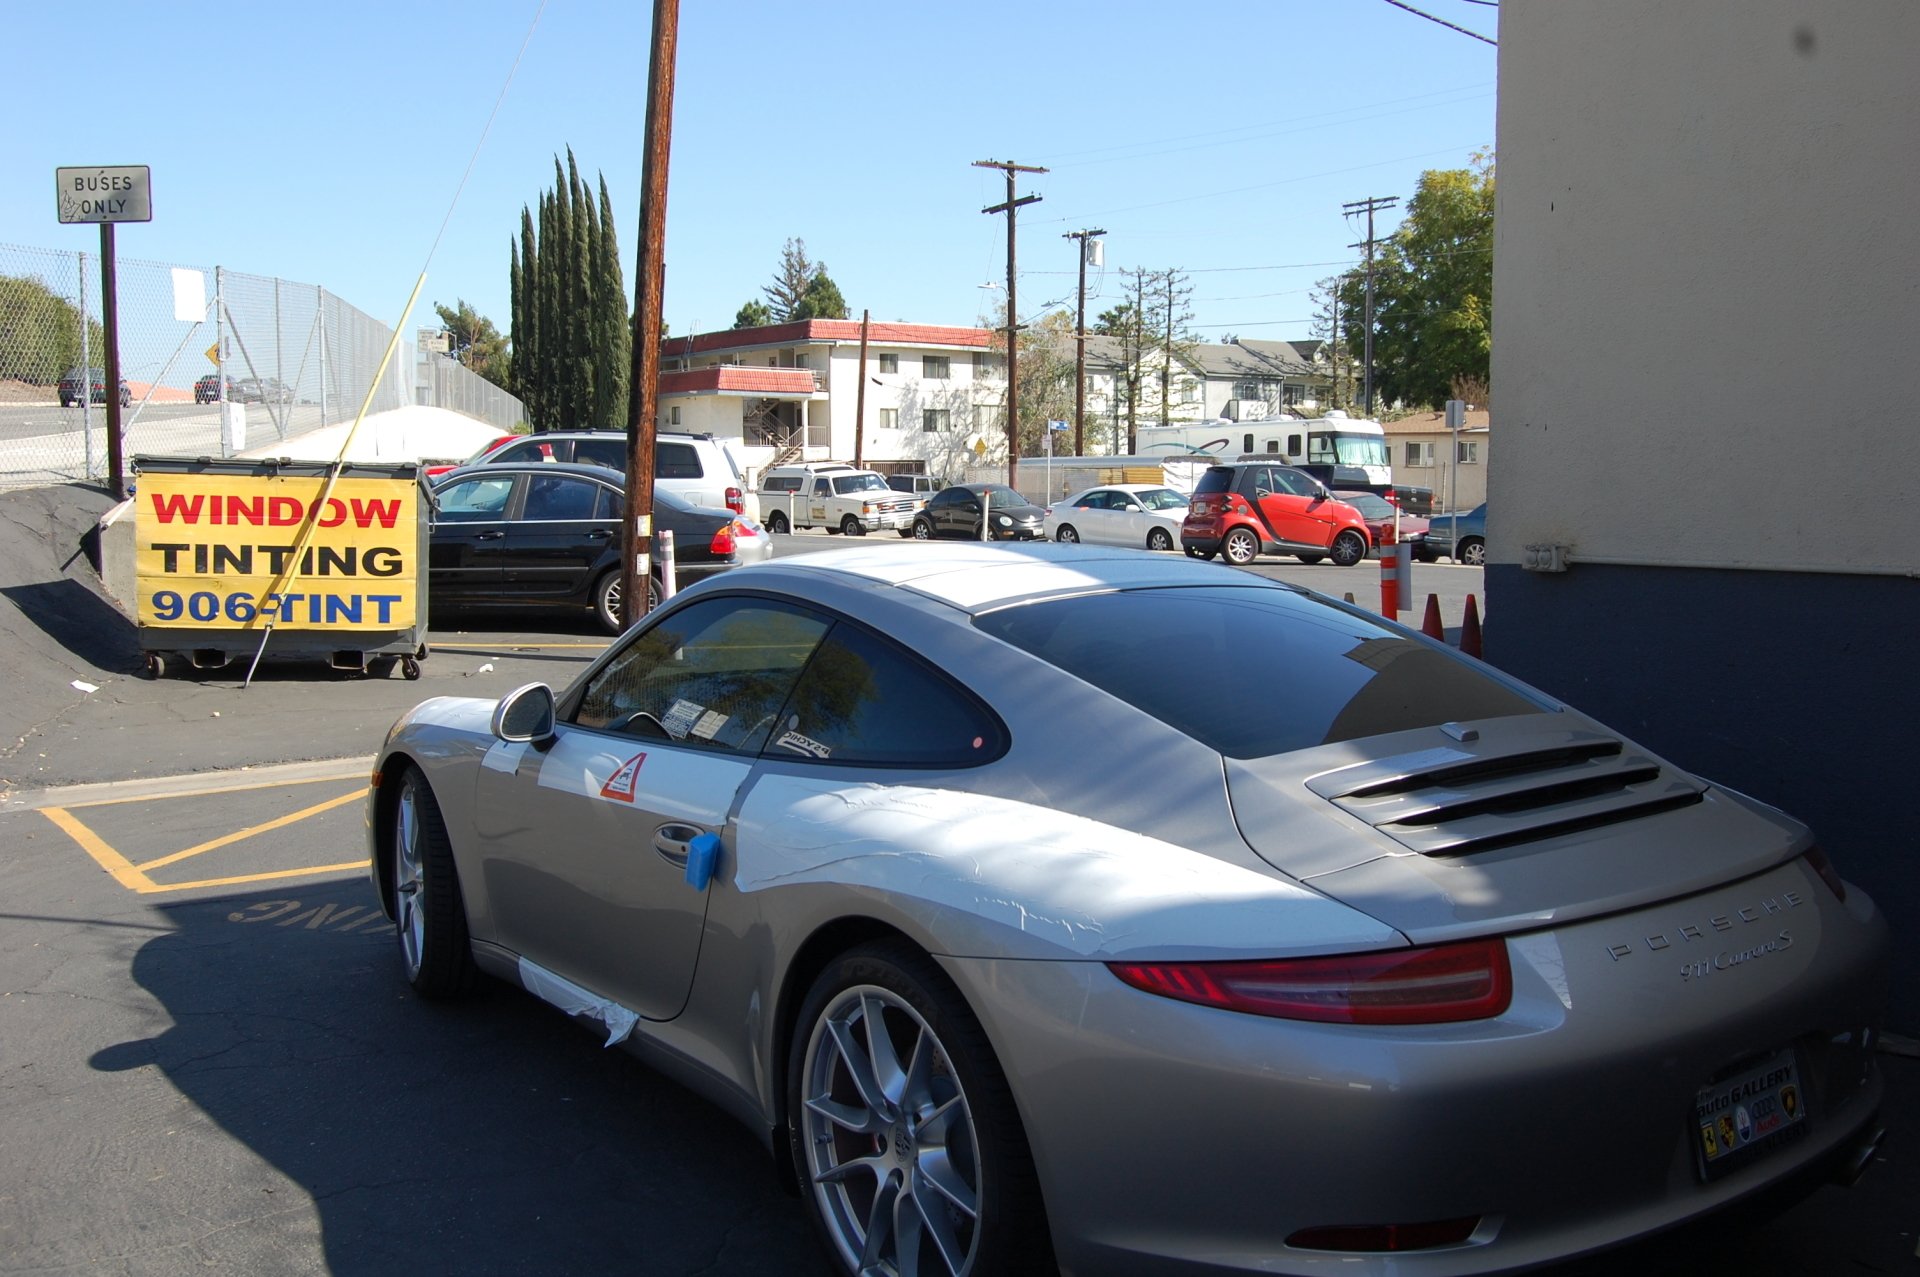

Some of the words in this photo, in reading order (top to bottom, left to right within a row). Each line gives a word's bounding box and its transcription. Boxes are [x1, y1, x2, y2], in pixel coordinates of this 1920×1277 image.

[75, 176, 132, 191] BUSES
[81, 199, 127, 215] ONLY
[151, 494, 402, 529] WINDOW
[151, 543, 403, 577] TINTING
[151, 590, 402, 624] 906-TINT
[1606, 890, 1803, 962] PORSCHE
[1679, 957, 1710, 982] 911
[1714, 940, 1777, 971] Carrera
[1778, 928, 1795, 952] S
